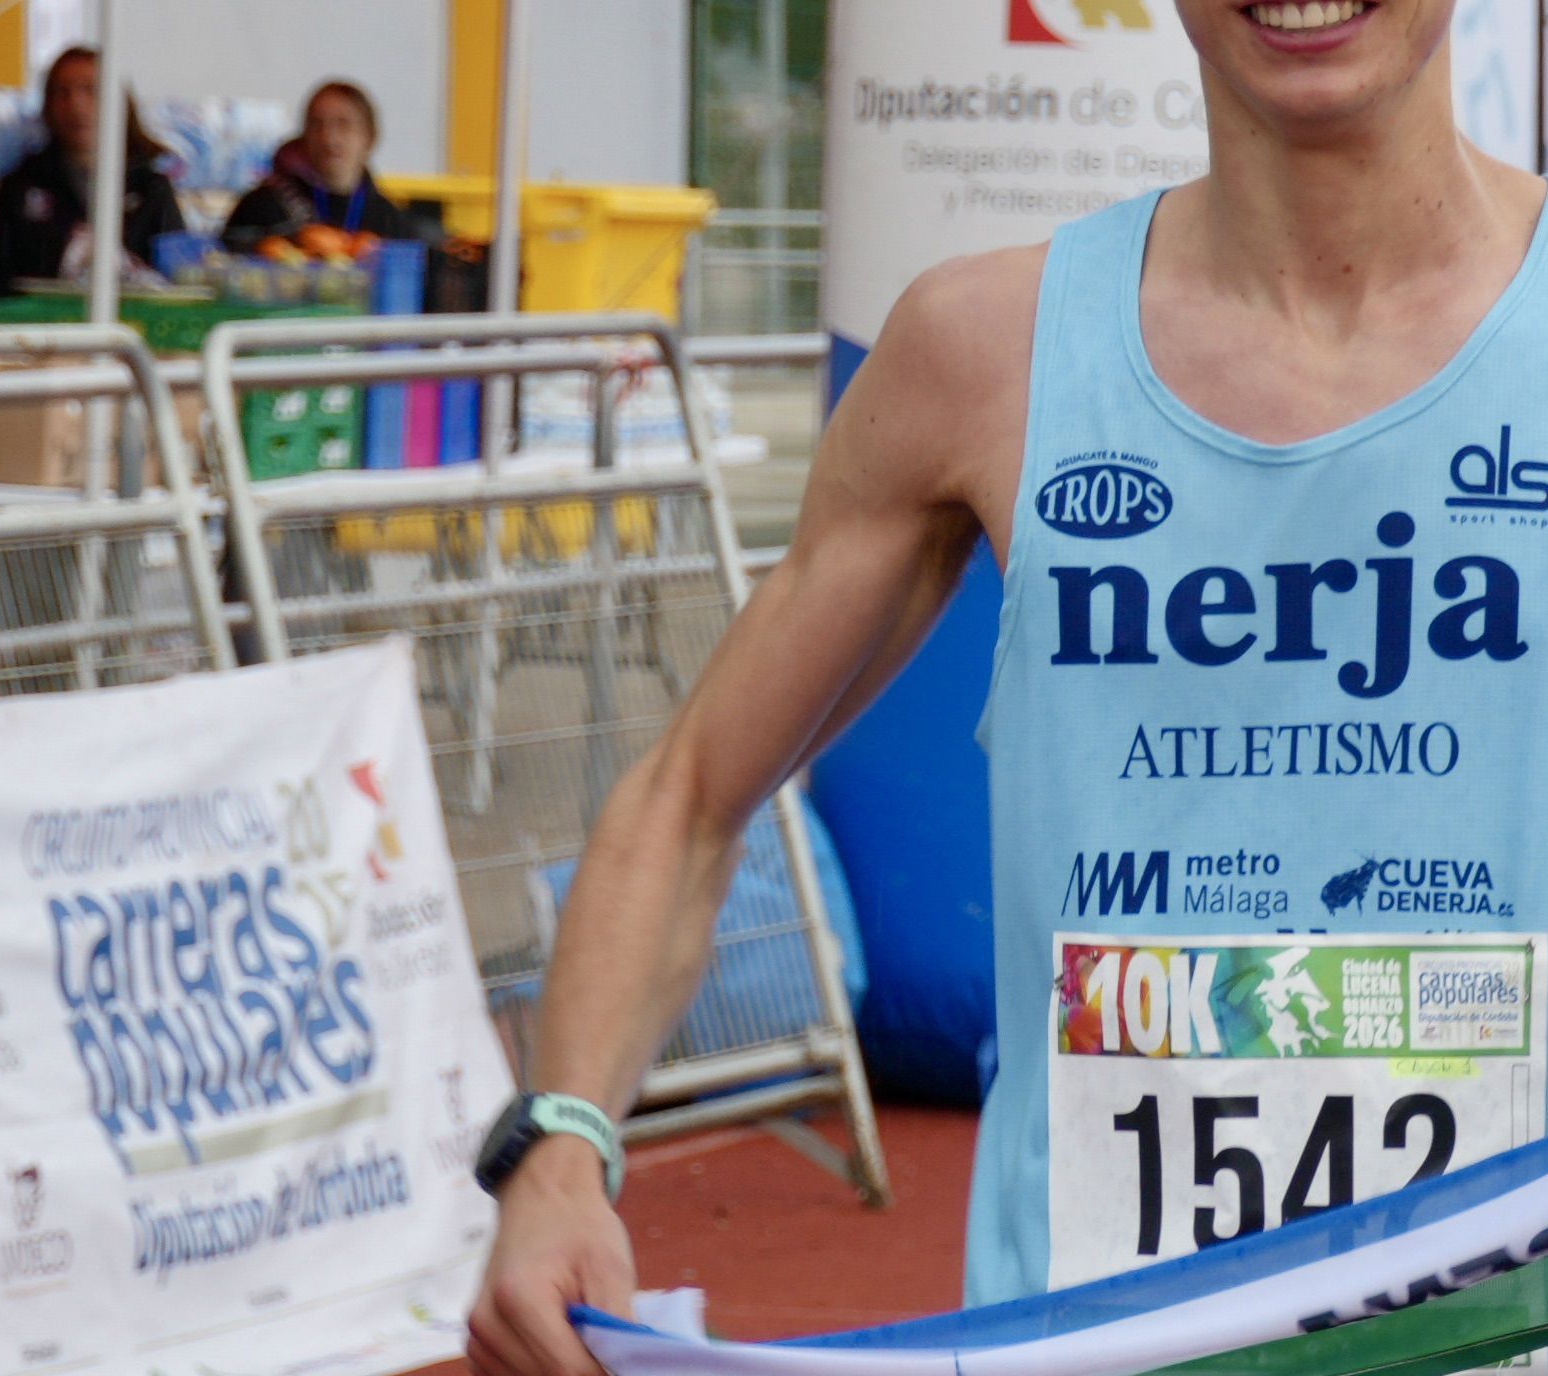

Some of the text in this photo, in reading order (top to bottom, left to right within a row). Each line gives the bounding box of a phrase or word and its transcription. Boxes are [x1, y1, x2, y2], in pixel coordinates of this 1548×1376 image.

[1069, 77, 1138, 127] de
[1055, 449, 1107, 471] AGUACATE
[1120, 452, 1159, 470] MANGO
[1042, 469, 1166, 526] TROPS
[1450, 514, 1548, 530] sport shop
[1048, 511, 1530, 699] nerja
[1118, 722, 1460, 779] ATLETISMO
[1185, 848, 1281, 877] metro
[1378, 858, 1494, 890] CUEVA
[1183, 884, 1290, 920] Málaga
[46, 865, 319, 1011] carreras
[1342, 975, 1402, 996] LUCENA
[1418, 971, 1504, 988] carreras
[1087, 950, 1221, 1055] 10K
[1418, 985, 1519, 1010] populares
[1342, 1015, 1404, 1049] 2026
